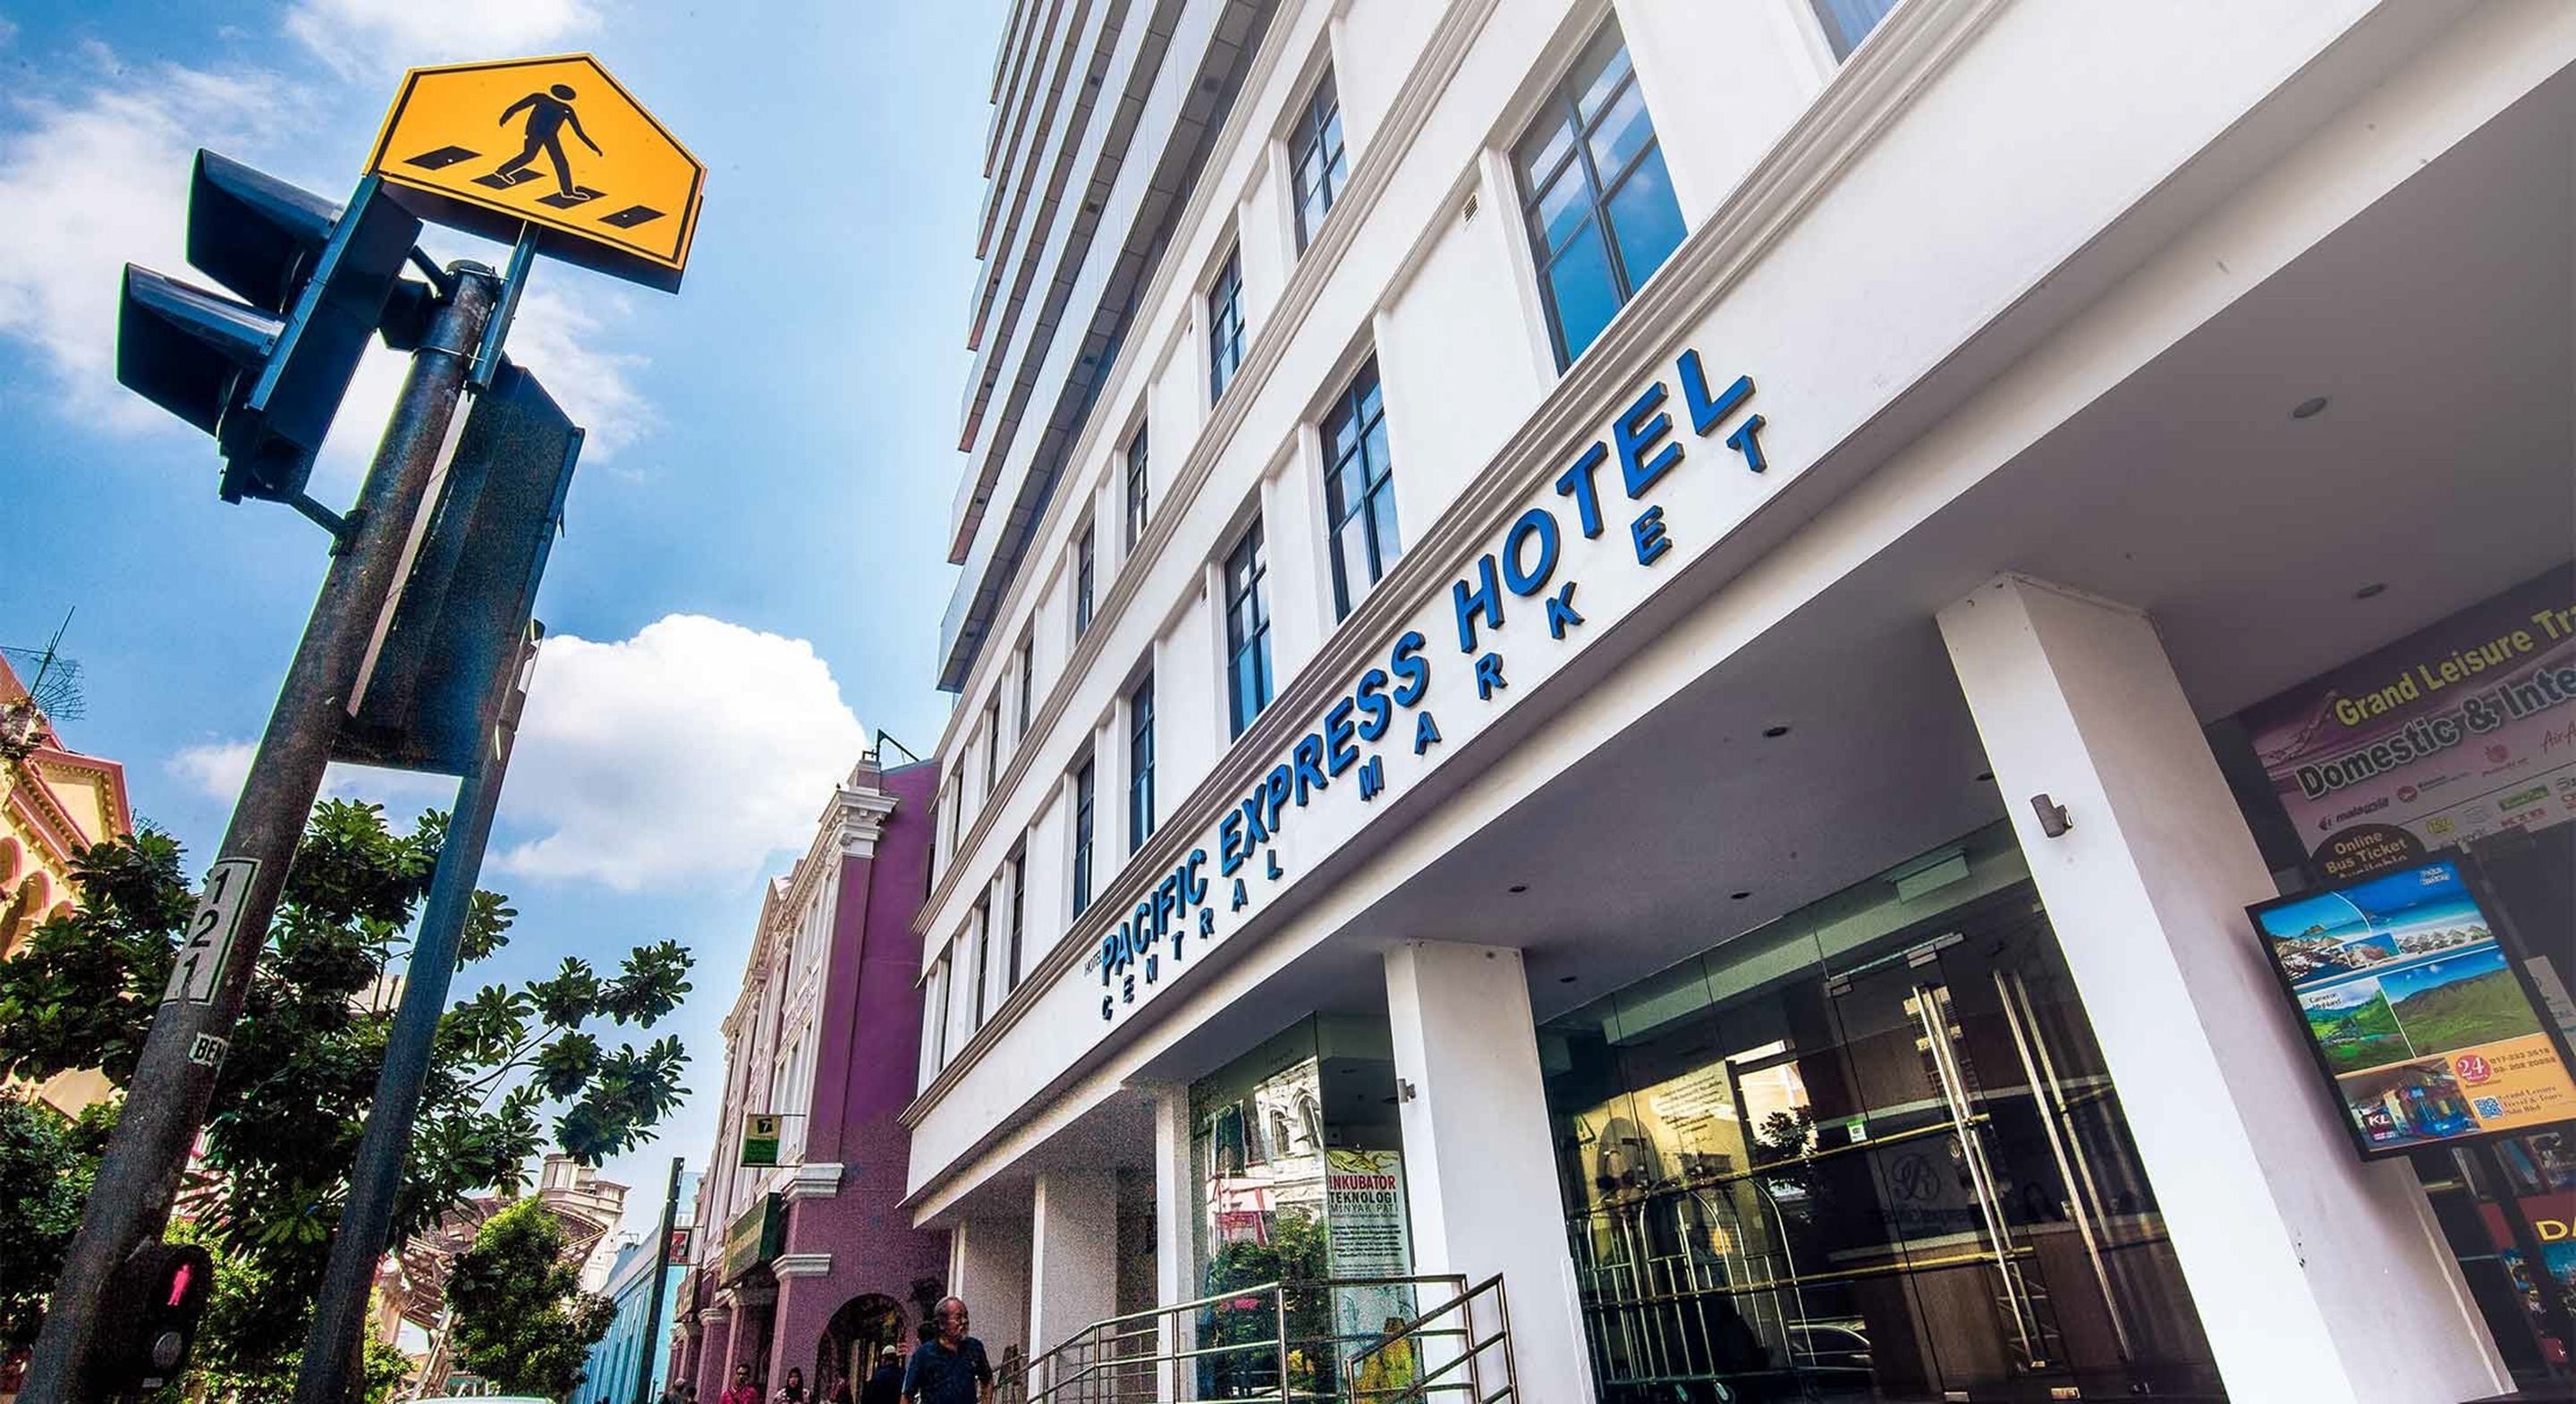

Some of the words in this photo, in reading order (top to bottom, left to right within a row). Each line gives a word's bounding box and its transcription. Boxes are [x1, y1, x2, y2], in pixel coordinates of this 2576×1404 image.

[1102, 848, 1208, 986] PACIFIC
[1219, 630, 1430, 878] EXPRESS
[1453, 348, 1756, 654] HOTEL
[2334, 672, 2419, 727] Grand
[2417, 629, 2535, 690] Leisure
[1102, 849, 1284, 1020] CENTRAL
[1359, 414, 1767, 802] MARKET
[2294, 717, 2462, 800] Domestic
[2462, 694, 2501, 733] &
[2326, 857, 2355, 874] Bus
[2355, 838, 2408, 862] Ticket
[2334, 832, 2383, 855] Online
[2457, 1057, 2485, 1077] 24
[2368, 1114, 2390, 1127] KL
[1328, 1174, 1396, 1190] INKUBATOR
[1329, 1191, 1397, 1204] TEKNOLOGI
